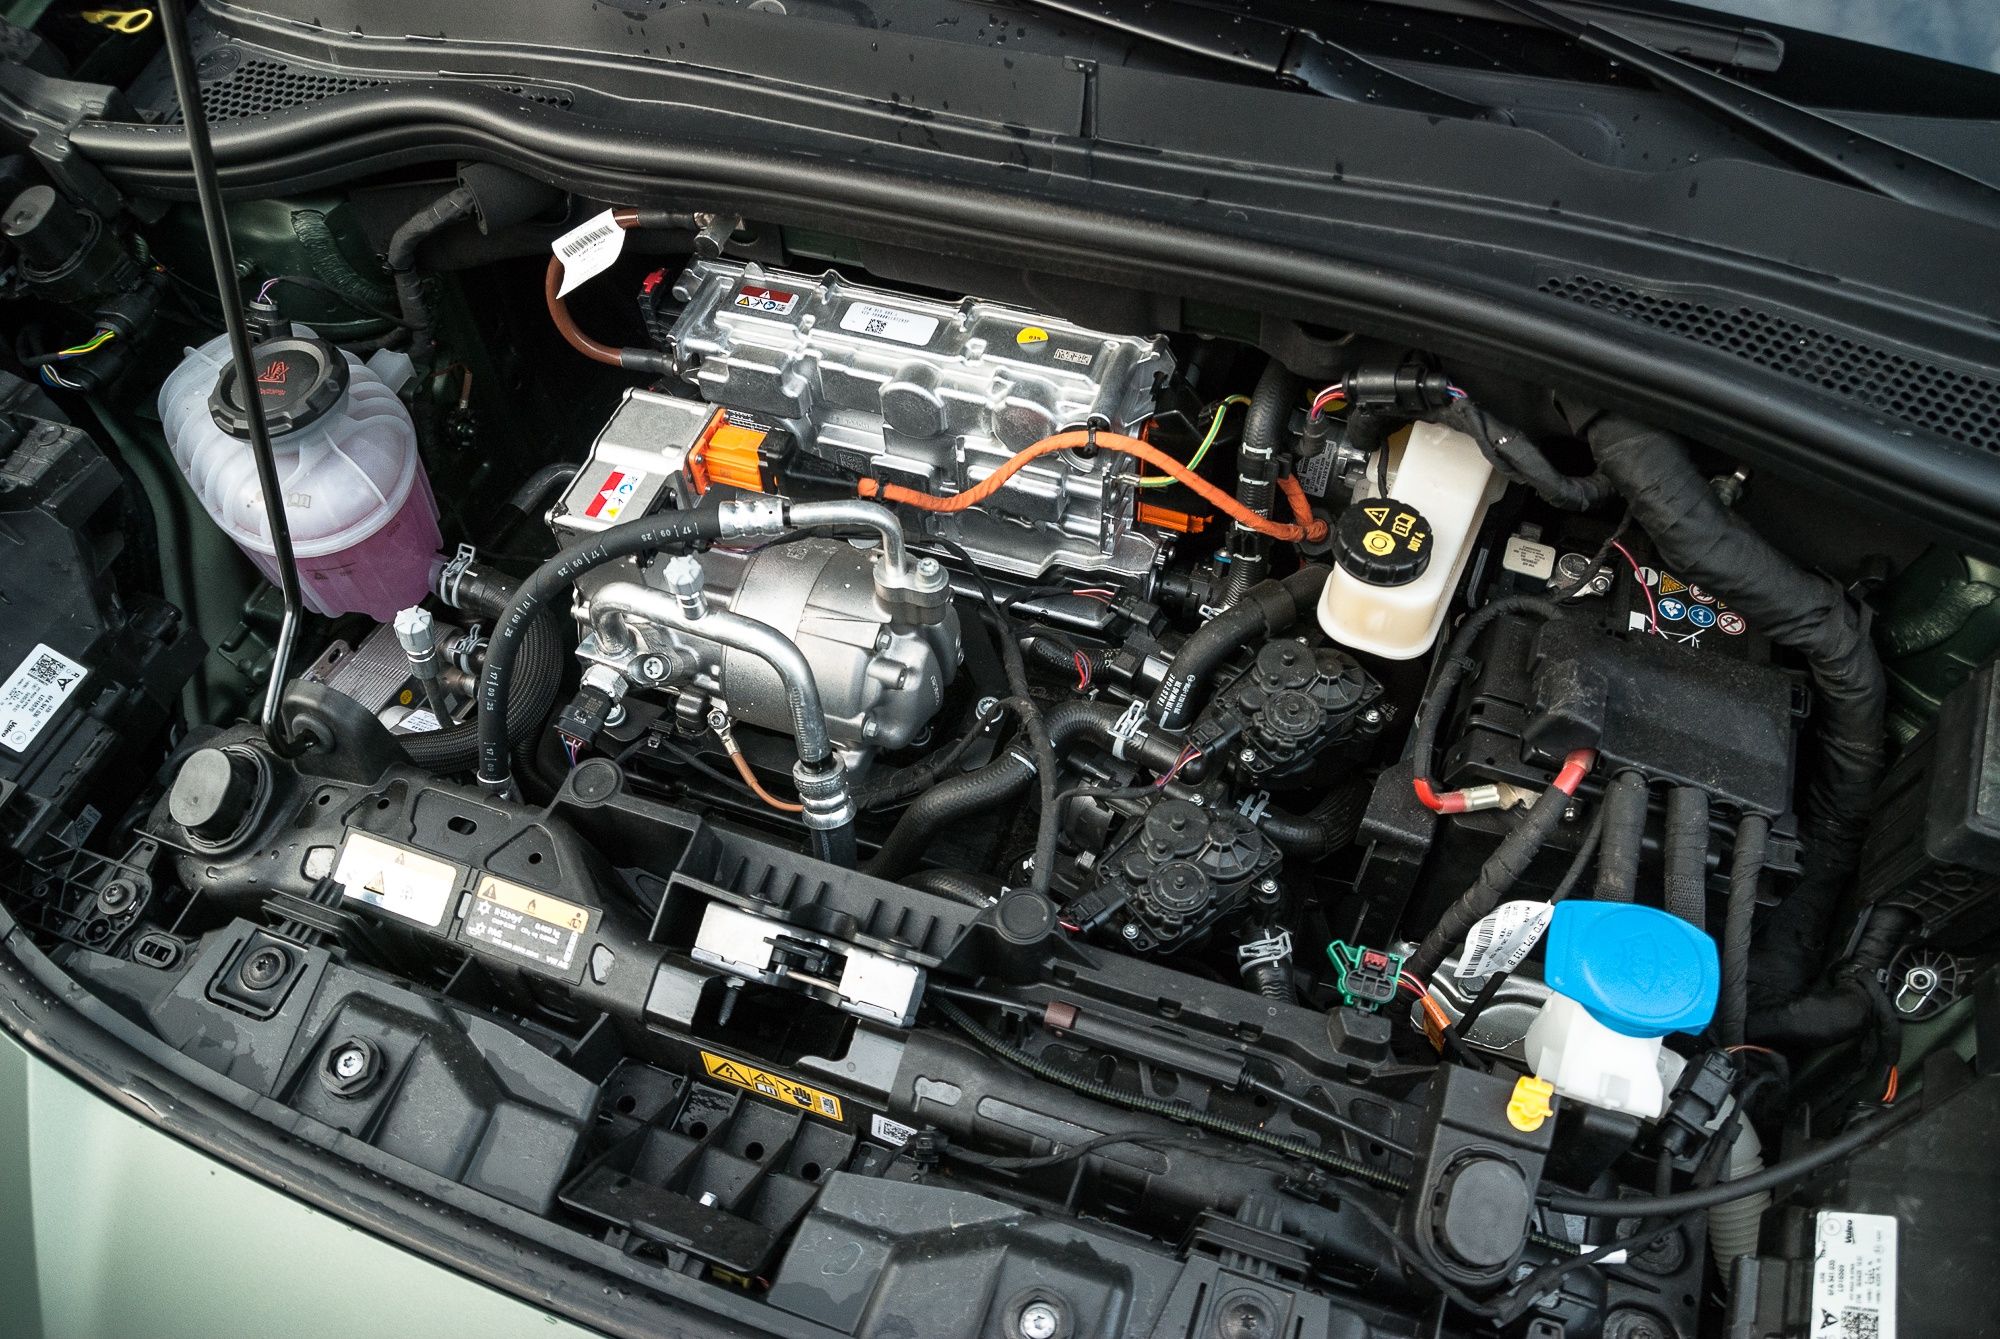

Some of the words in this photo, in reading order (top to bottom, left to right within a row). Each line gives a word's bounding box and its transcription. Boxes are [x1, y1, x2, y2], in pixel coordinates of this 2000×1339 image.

[1407, 537, 1422, 552] DOT
[1156, 673, 1176, 707] TRISTONE
[1, 721, 17, 738] Valeo
[1523, 935, 1536, 947] 971
[1513, 948, 1526, 959] 111
[1845, 1219, 1853, 1243] Valeo
